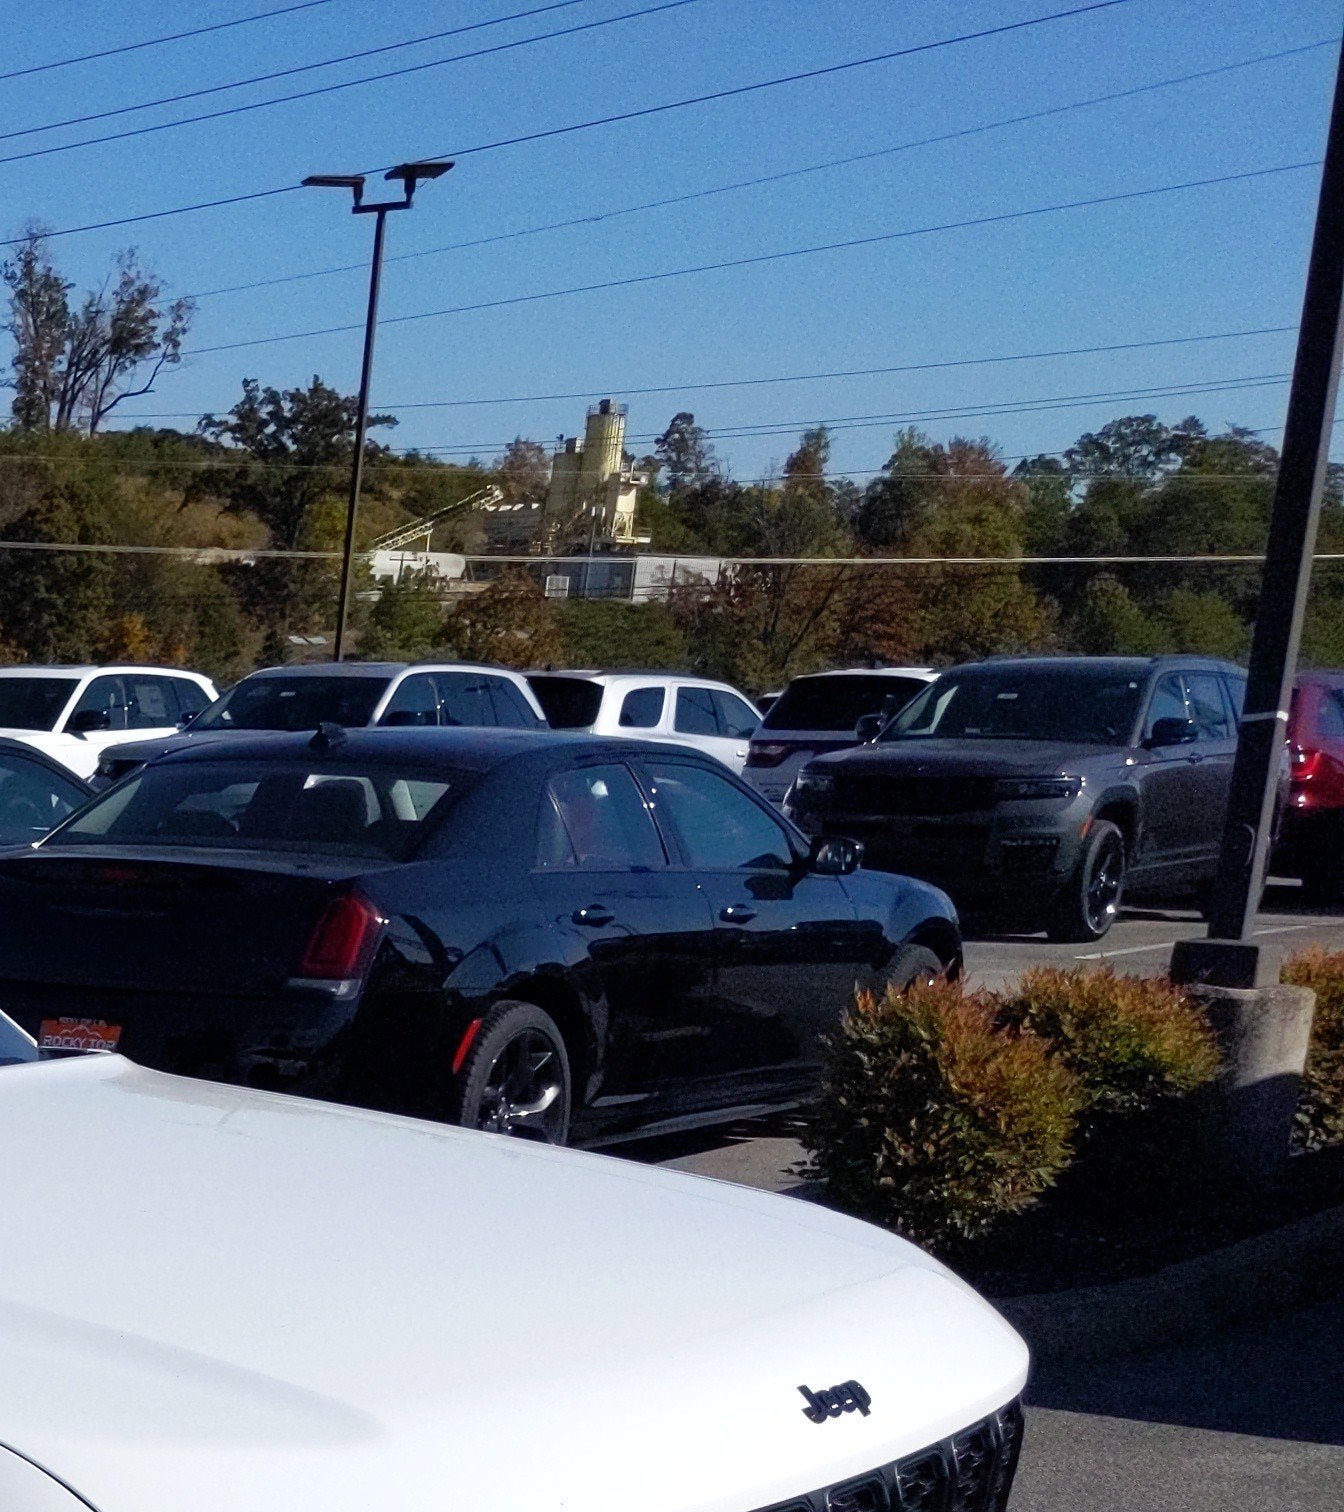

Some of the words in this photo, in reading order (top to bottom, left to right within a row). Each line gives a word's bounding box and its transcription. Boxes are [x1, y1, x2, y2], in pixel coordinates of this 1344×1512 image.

[43, 1035, 86, 1048] ROCKY
[88, 1039, 117, 1050] TOP
[797, 1379, 871, 1424] Jeep
